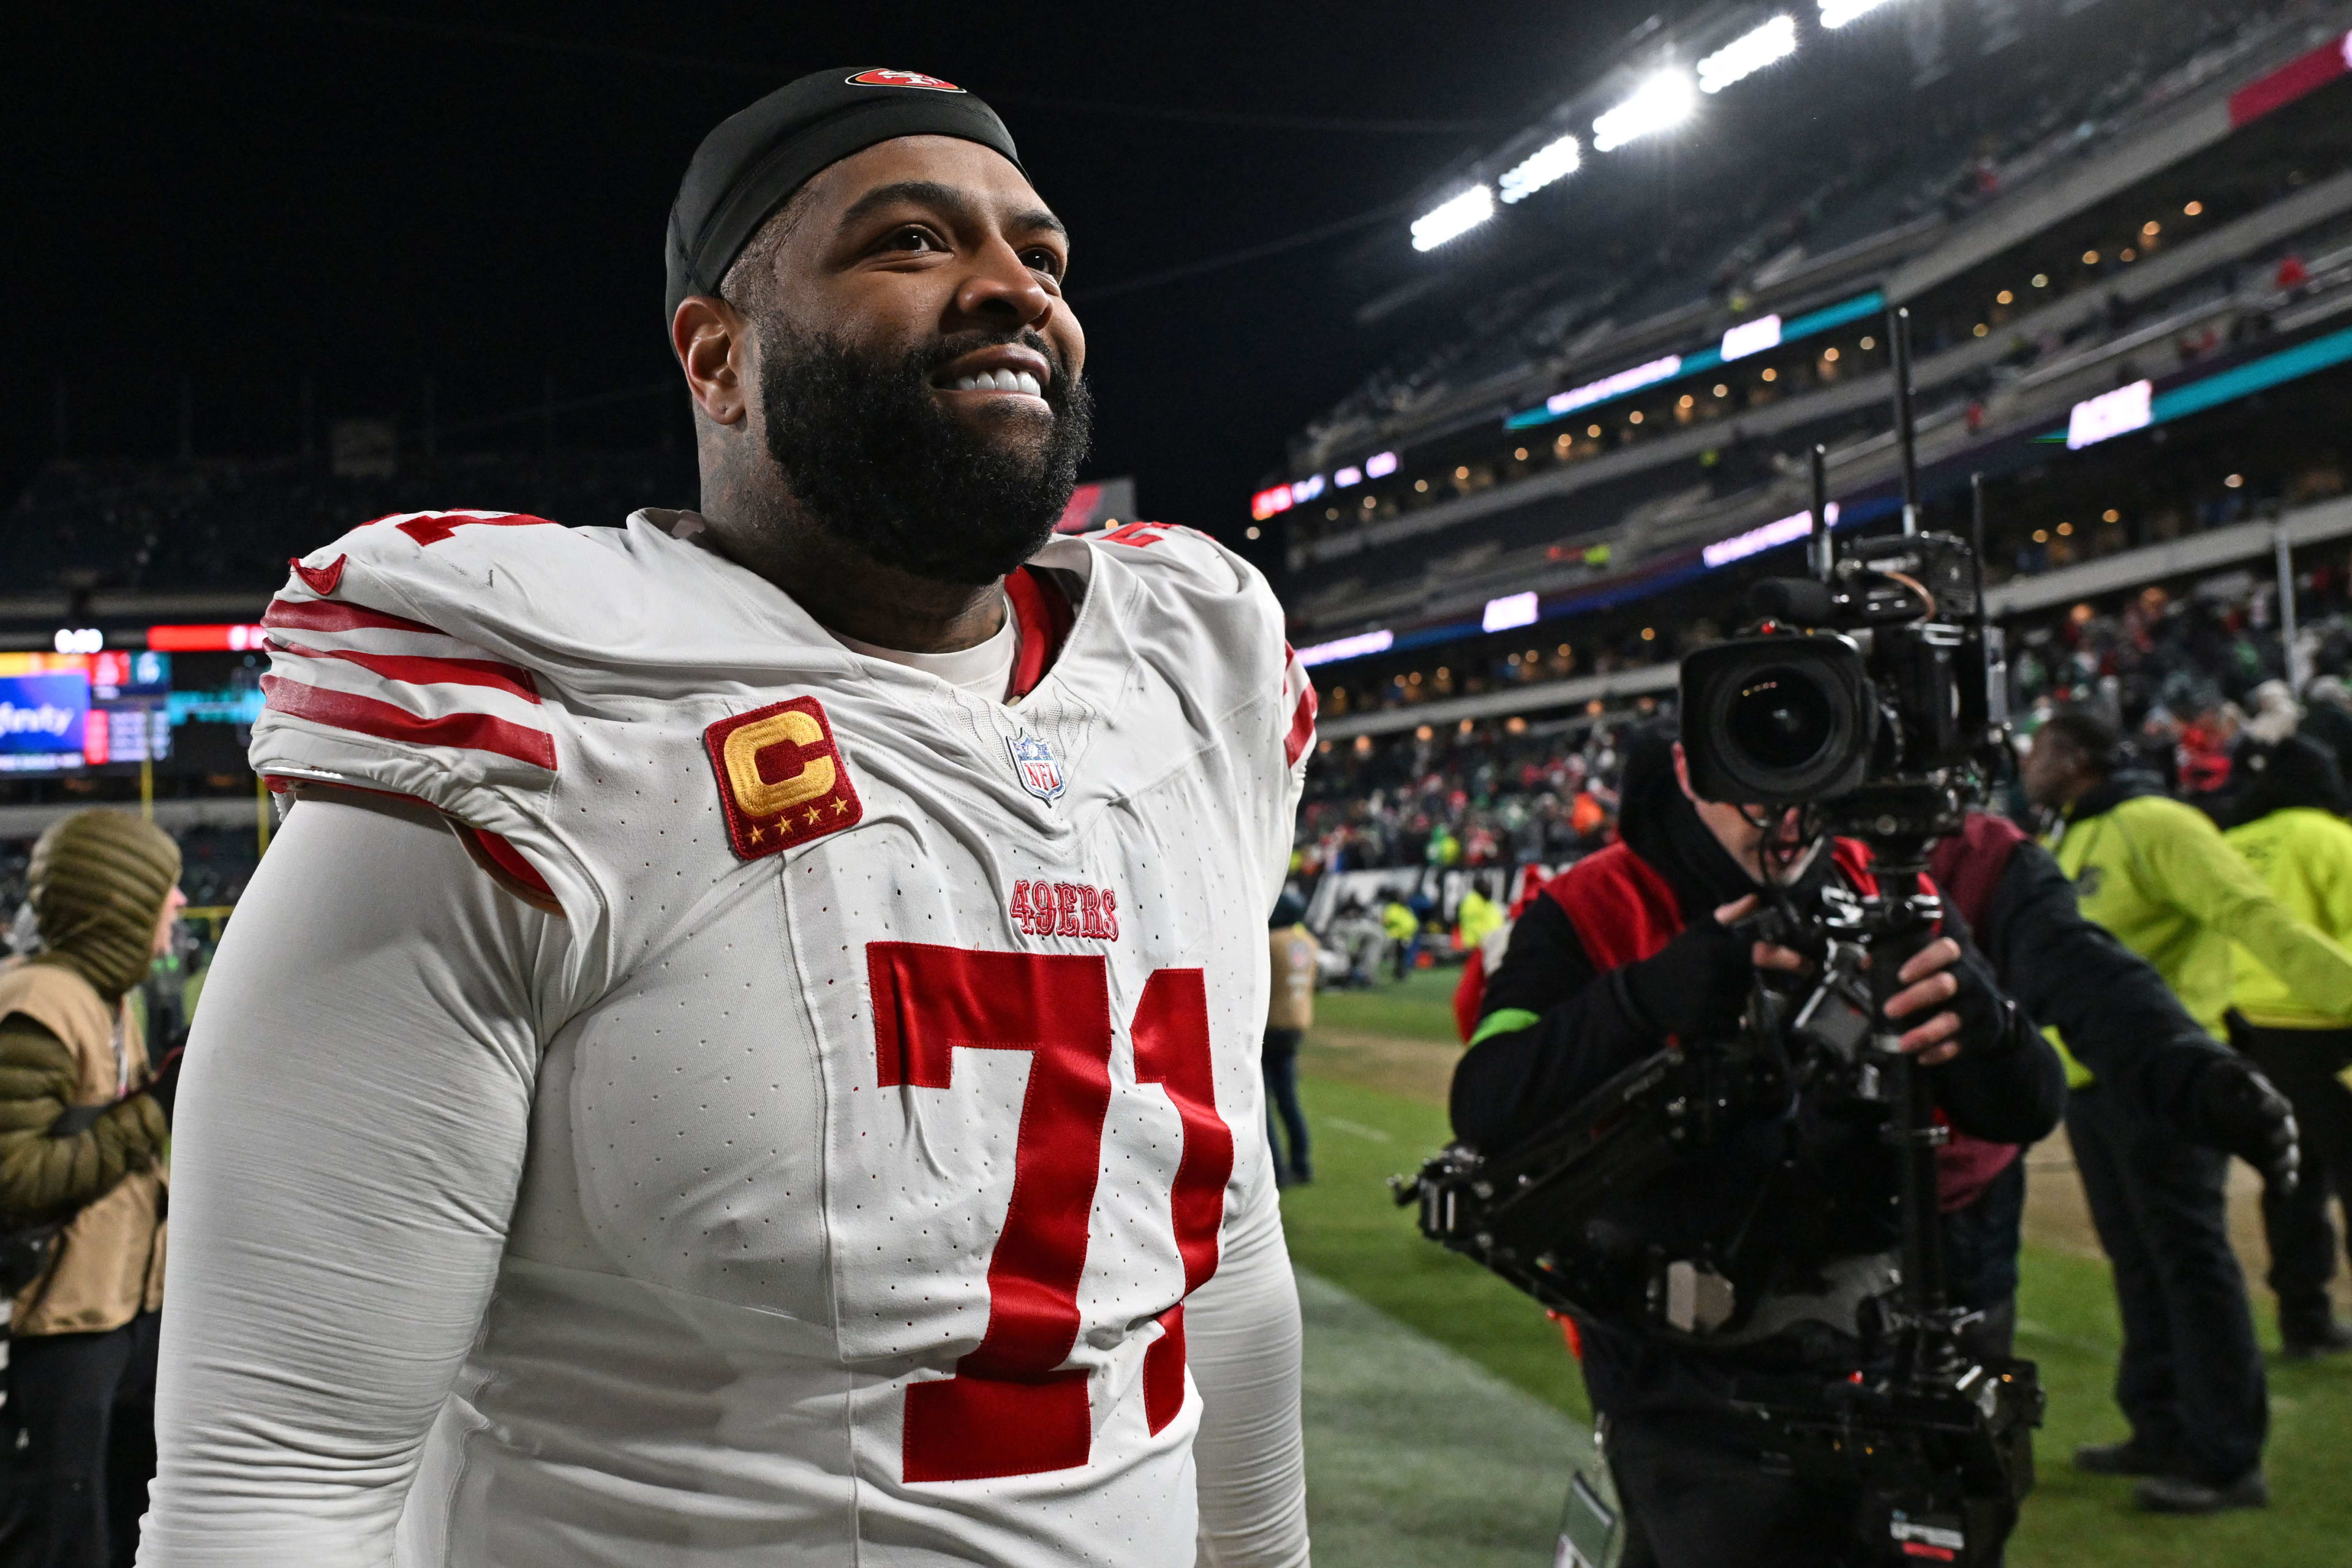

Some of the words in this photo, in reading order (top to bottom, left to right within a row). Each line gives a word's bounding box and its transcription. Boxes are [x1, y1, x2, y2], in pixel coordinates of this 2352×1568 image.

[723, 710, 836, 817] C
[1024, 763, 1060, 791] NFL
[1011, 880, 1119, 942] 49ERS
[867, 940, 1234, 1483] 71
